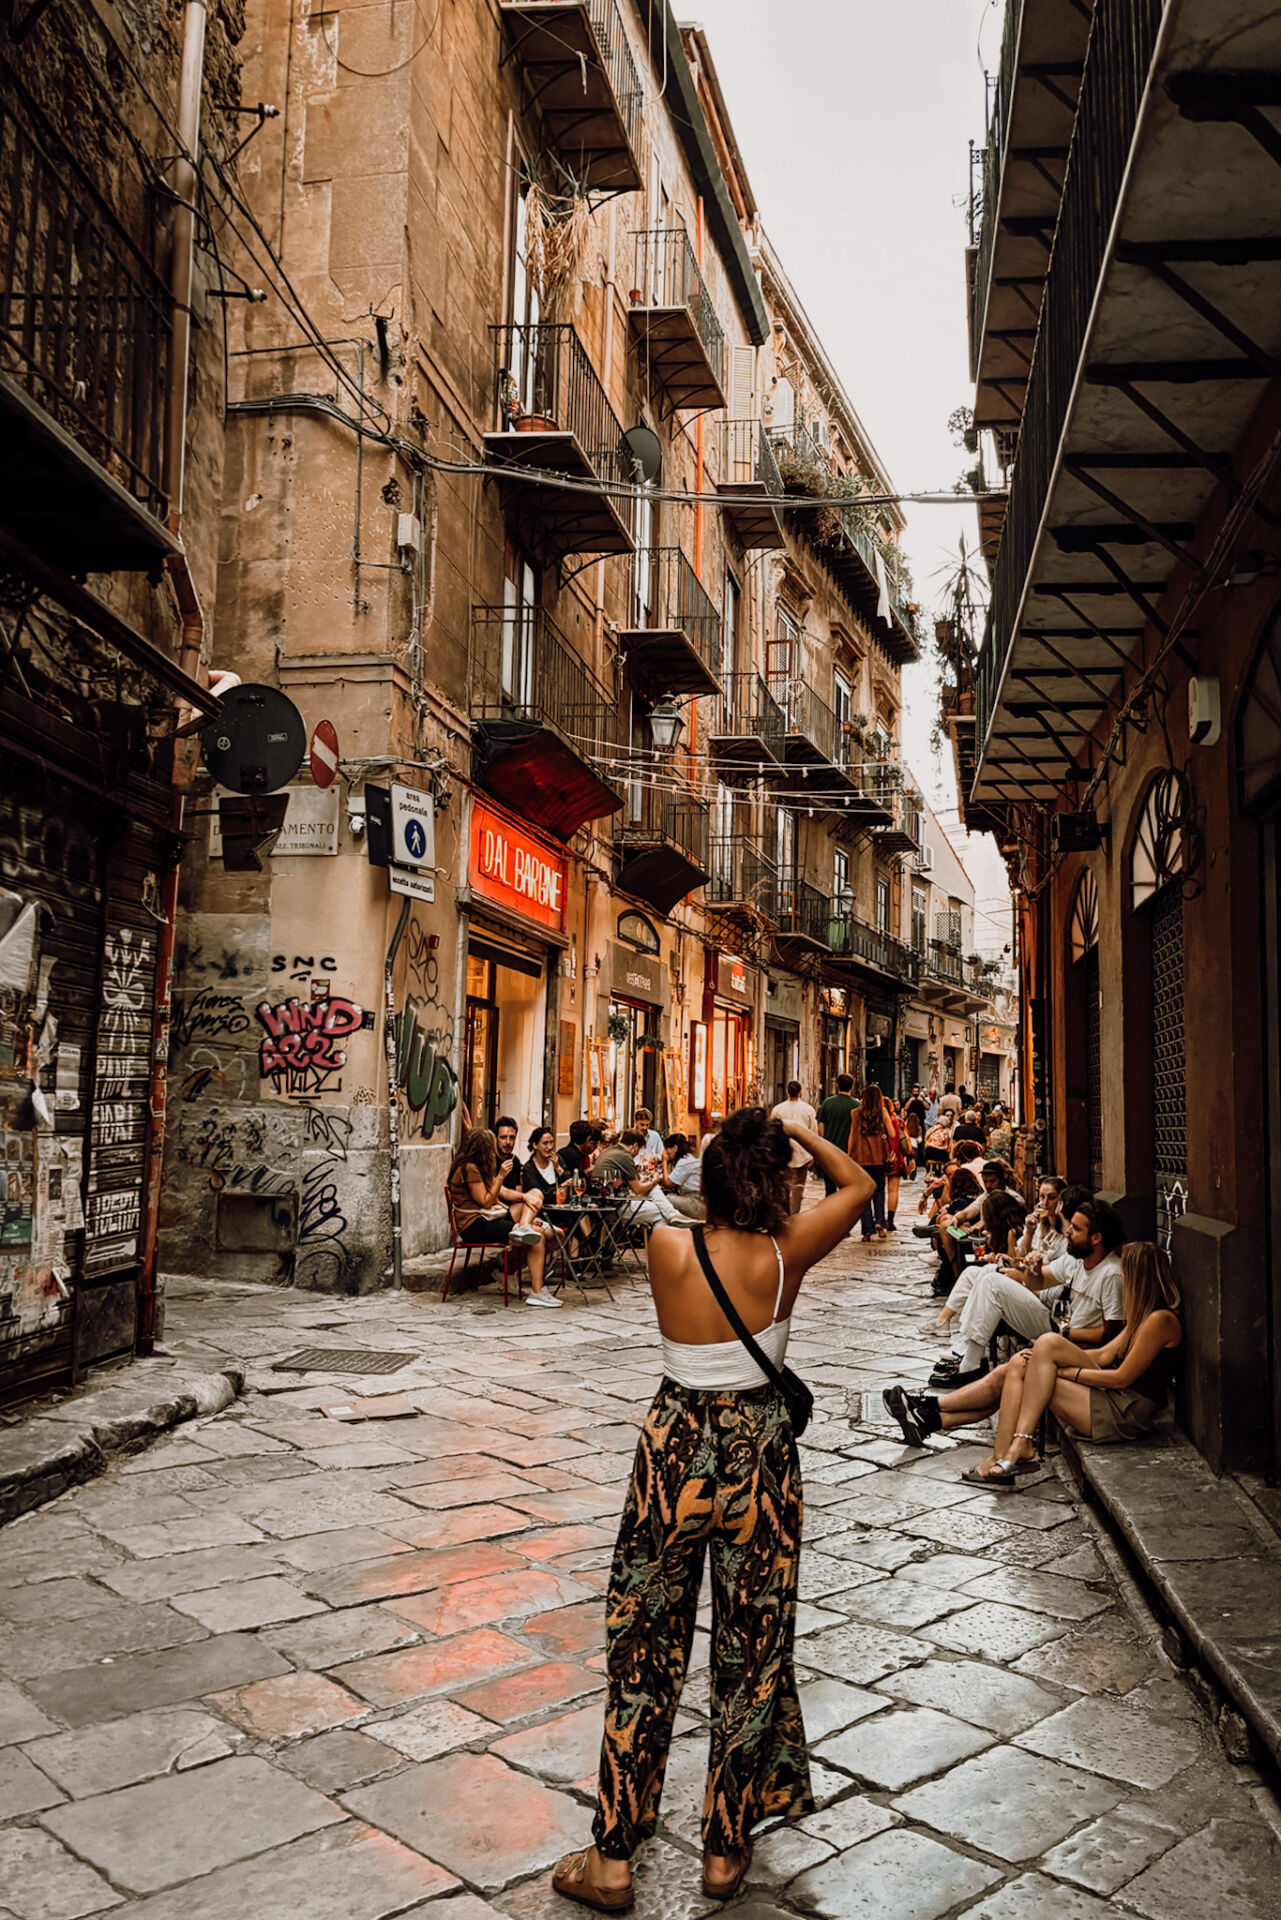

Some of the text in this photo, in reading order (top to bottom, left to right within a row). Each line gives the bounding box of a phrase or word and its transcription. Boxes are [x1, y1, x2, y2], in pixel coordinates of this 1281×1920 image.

[406, 792, 420, 803] area
[399, 802, 428, 817] pedonale
[485, 829, 512, 886] DAL
